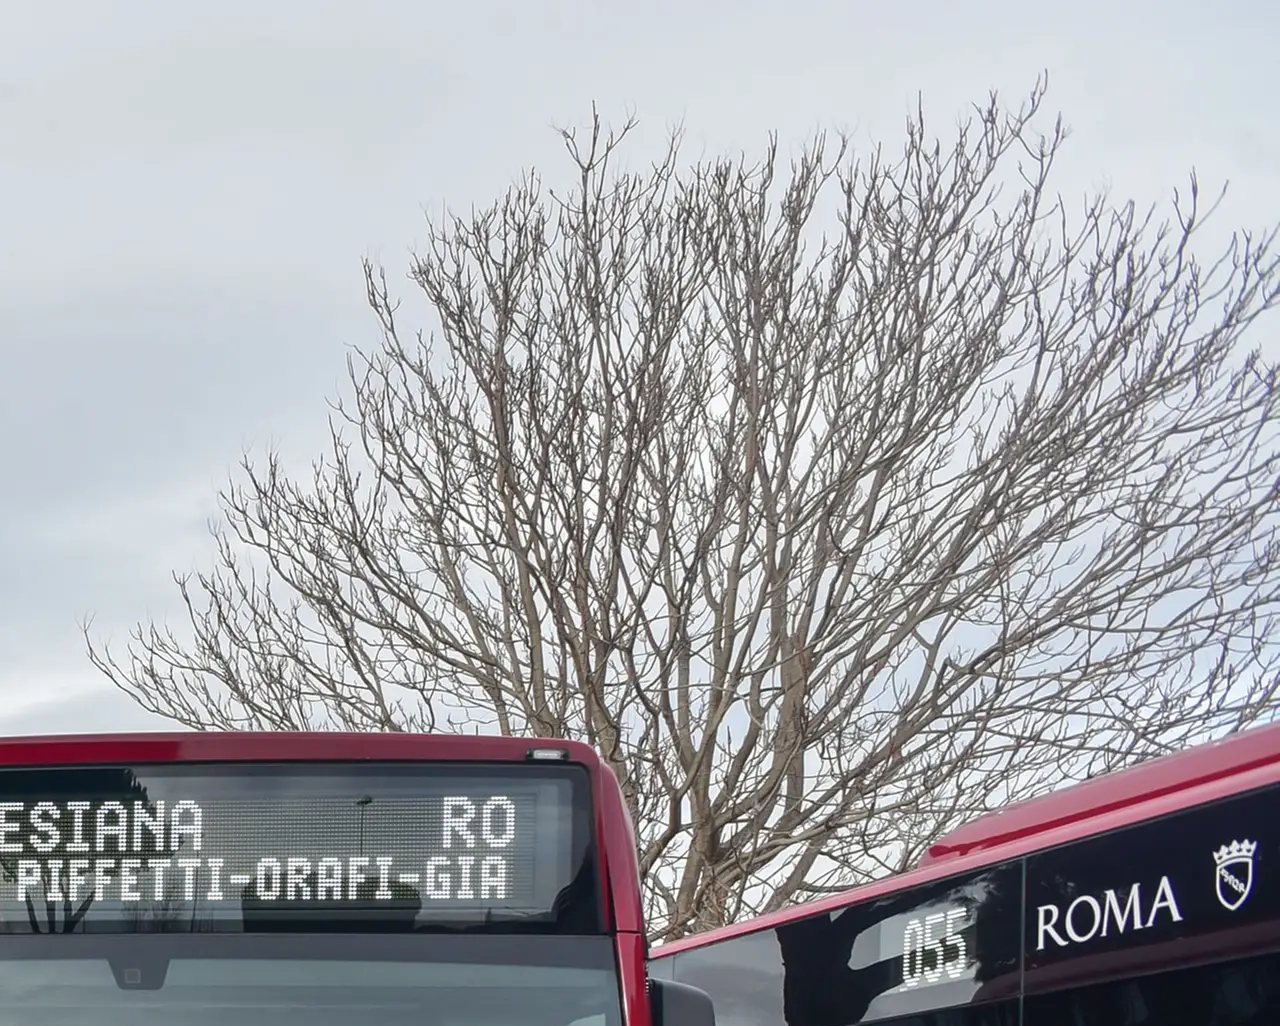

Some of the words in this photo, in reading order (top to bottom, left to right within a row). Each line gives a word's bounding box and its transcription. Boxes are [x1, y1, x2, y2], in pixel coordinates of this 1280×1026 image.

[442, 796, 515, 849] RO
[16, 857, 507, 902] PIFFETTI-ORAFI-GIA
[1036, 875, 1183, 950] ROMA
[902, 907, 968, 987] 055
